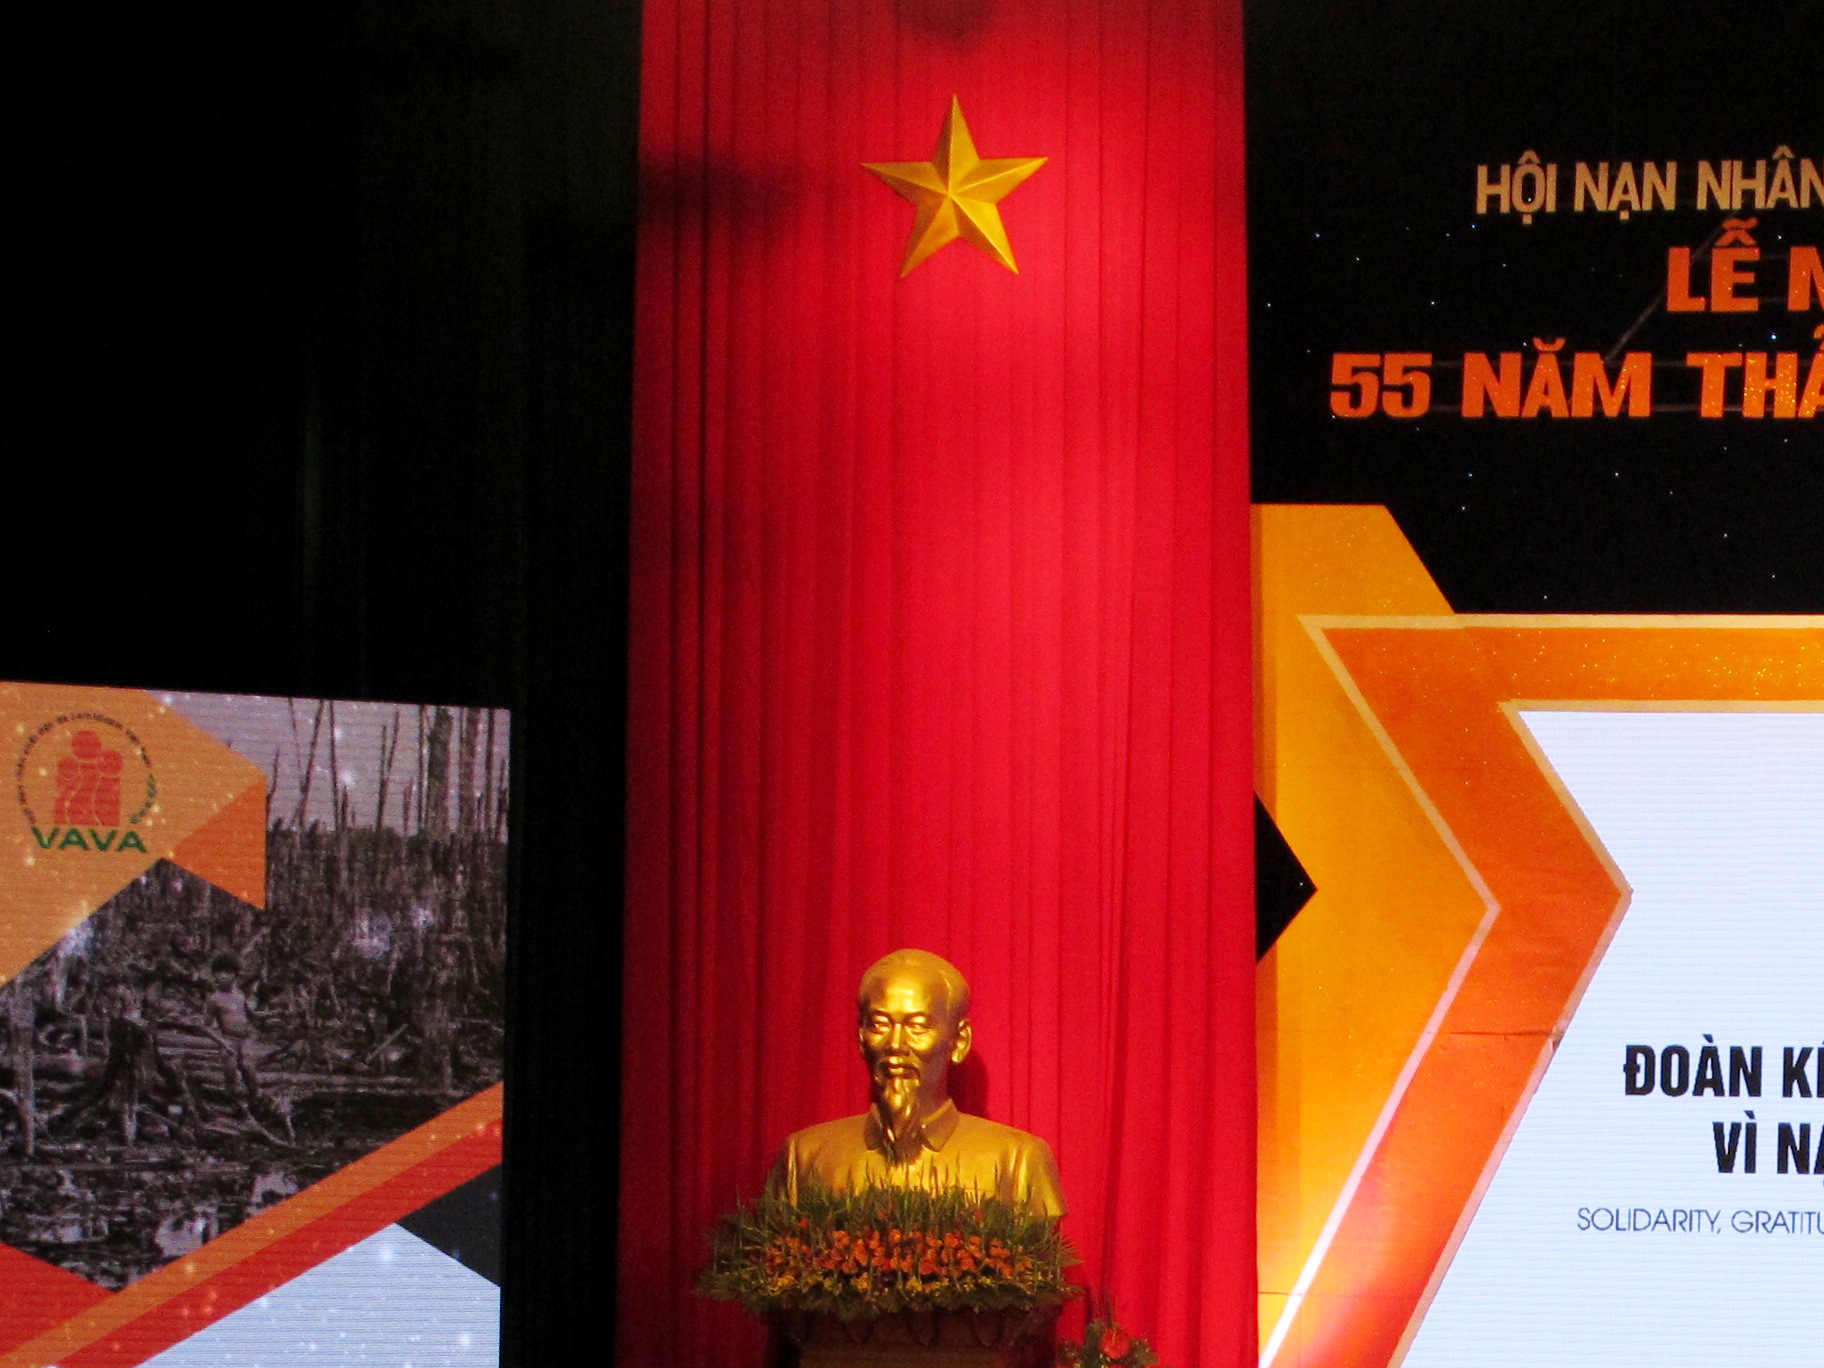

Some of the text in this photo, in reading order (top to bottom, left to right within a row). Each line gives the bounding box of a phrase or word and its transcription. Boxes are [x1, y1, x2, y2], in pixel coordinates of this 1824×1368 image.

[1476, 149, 1557, 224] HỘI
[1574, 162, 1677, 220] NẠN
[1667, 218, 1759, 312] LỄ
[1330, 353, 1432, 418] 55
[1462, 338, 1652, 418] NĂM
[31, 826, 146, 852] VAVA
[1623, 1034, 1762, 1098] ĐOÀN
[1712, 1110, 1757, 1174] VÌ
[1577, 1207, 1723, 1236] SOLIDARITY,
